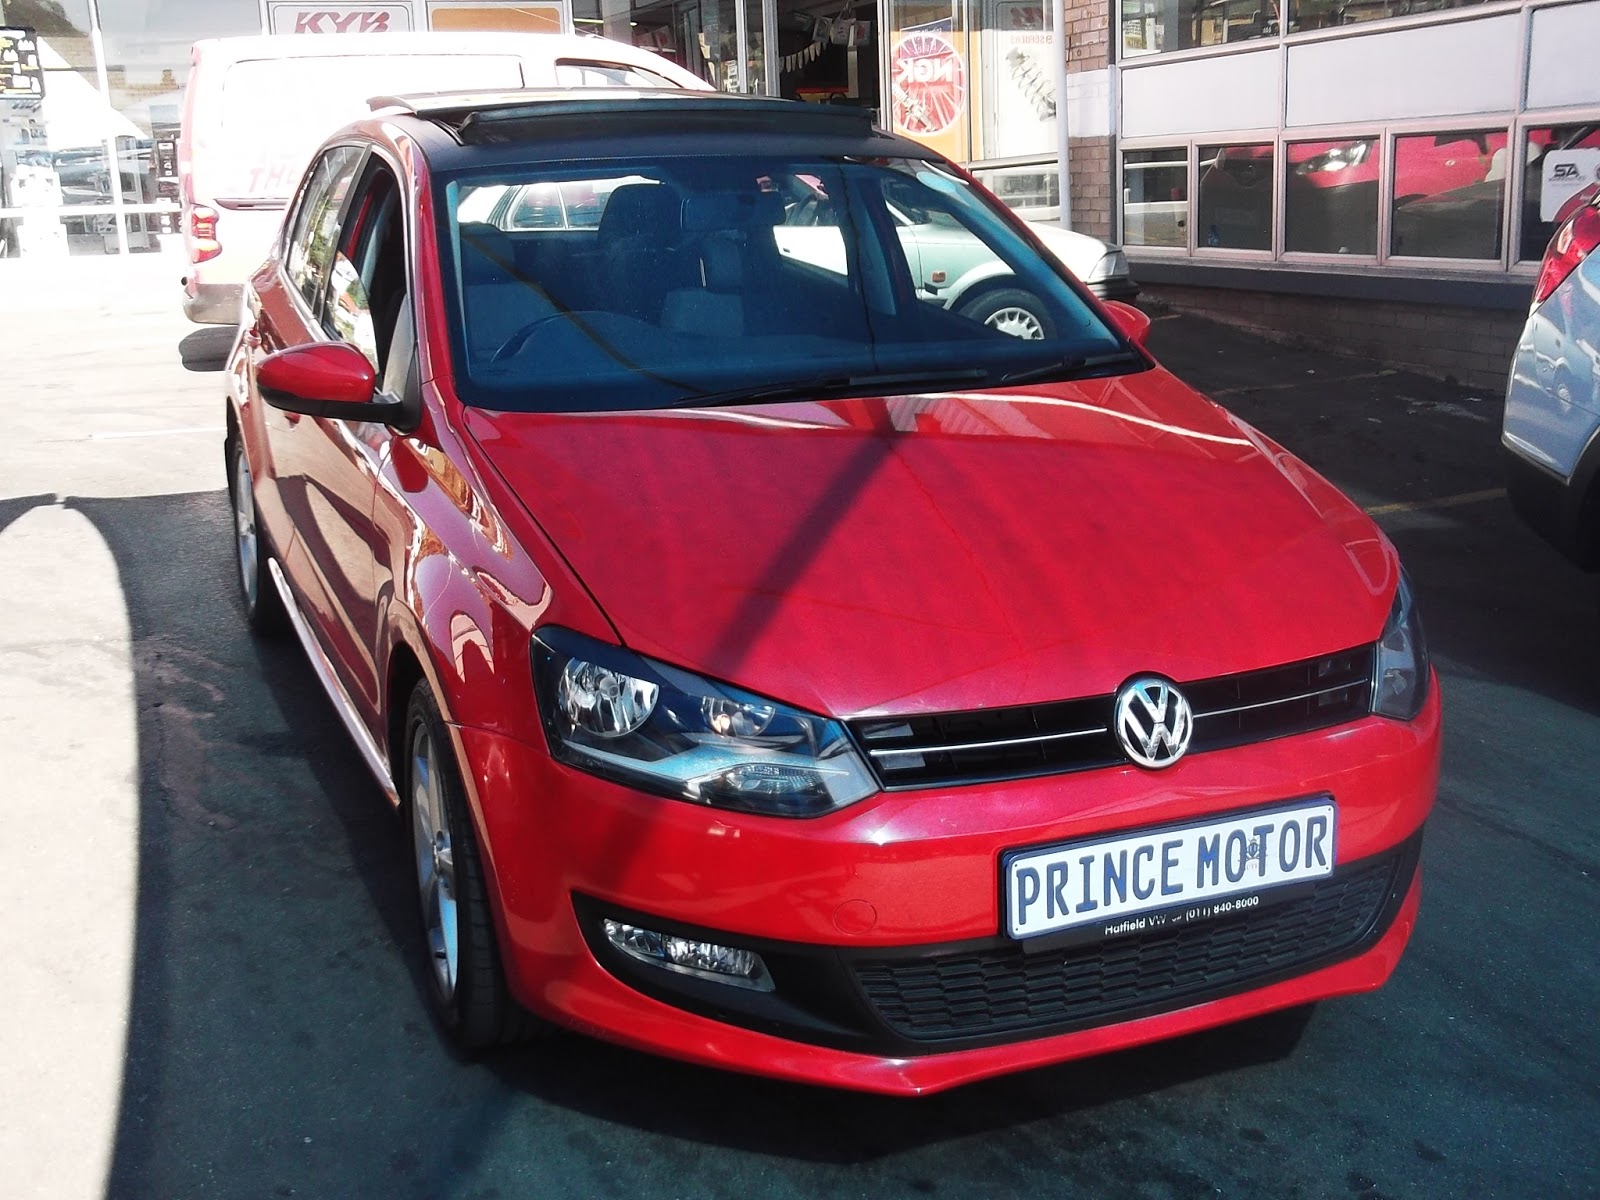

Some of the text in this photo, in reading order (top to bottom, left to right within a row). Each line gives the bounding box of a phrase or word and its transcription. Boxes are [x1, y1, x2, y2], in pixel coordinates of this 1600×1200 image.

[294, 11, 390, 34] KYB
[1016, 815, 1328, 925] PRINCE MOTOR
[1104, 917, 1146, 935] Hatfield
[1213, 896, 1259, 914] 840-8000
